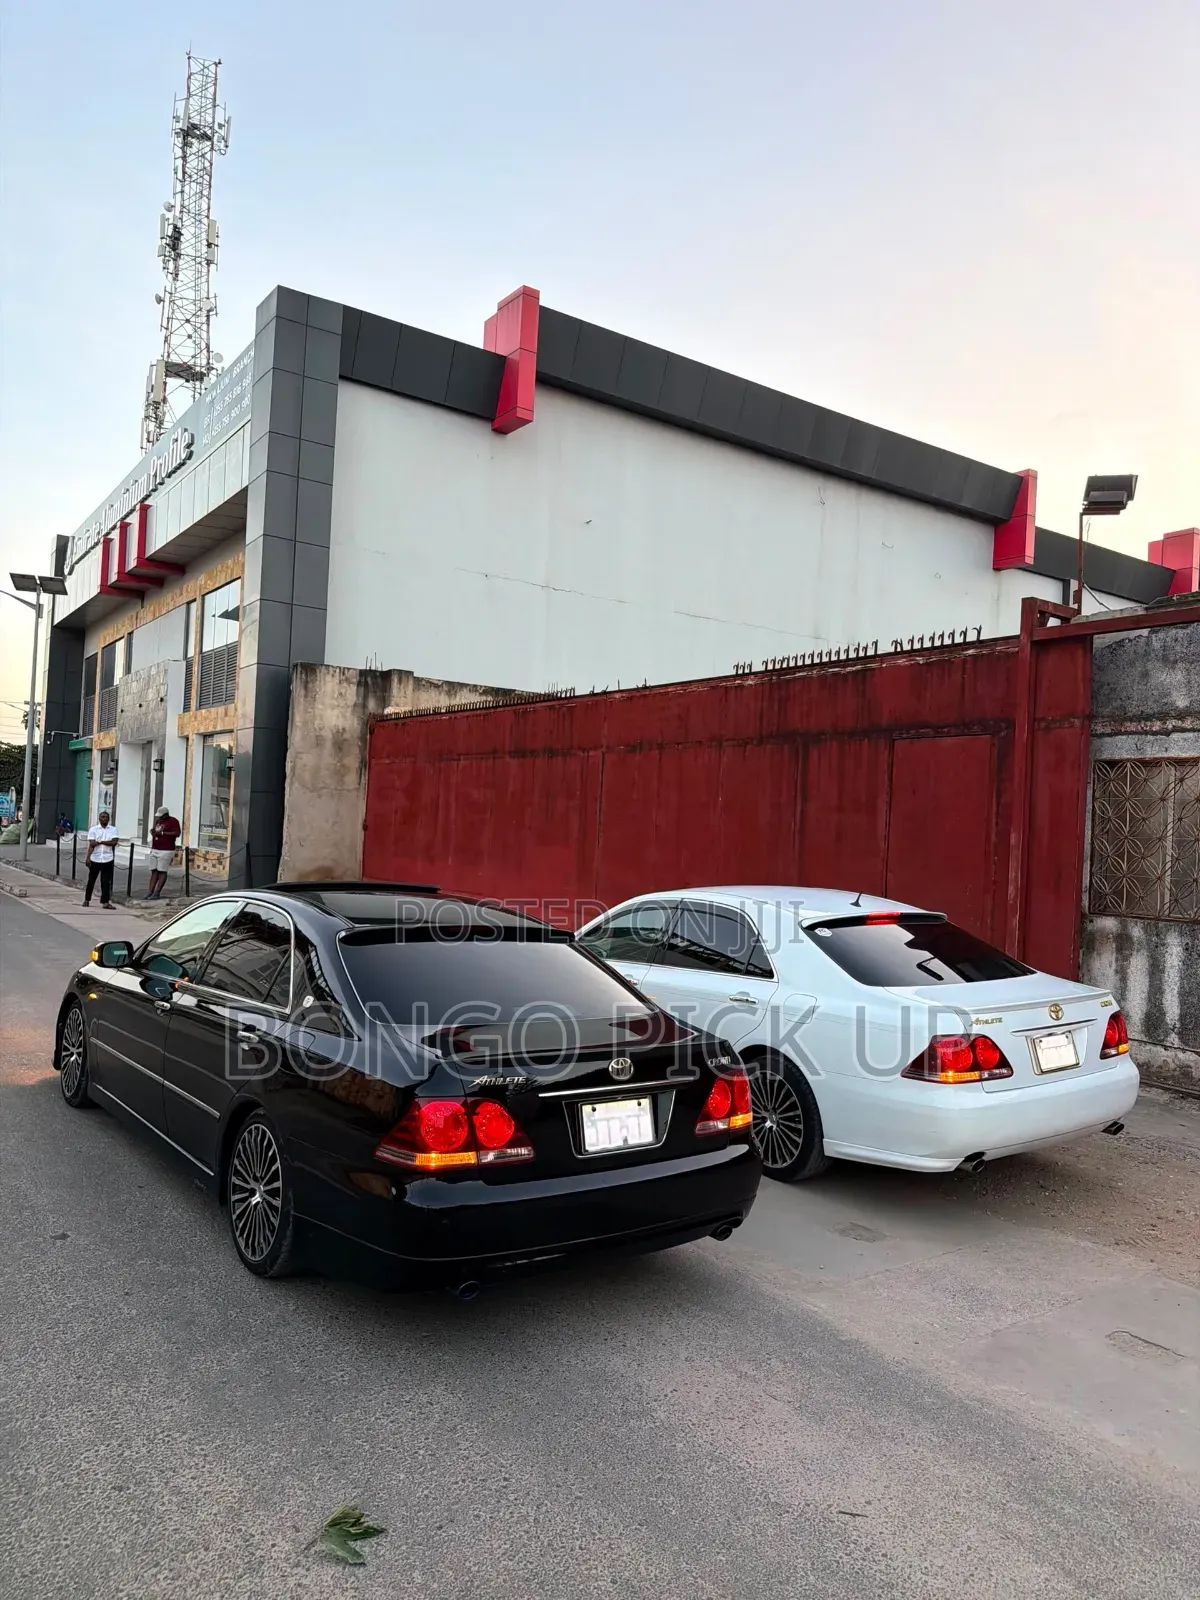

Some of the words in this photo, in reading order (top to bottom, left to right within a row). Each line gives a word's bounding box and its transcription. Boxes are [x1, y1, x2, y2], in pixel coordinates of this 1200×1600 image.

[232, 347, 254, 378] BRANCH
[101, 472, 151, 536] Aluminium
[150, 427, 194, 491] Profile
